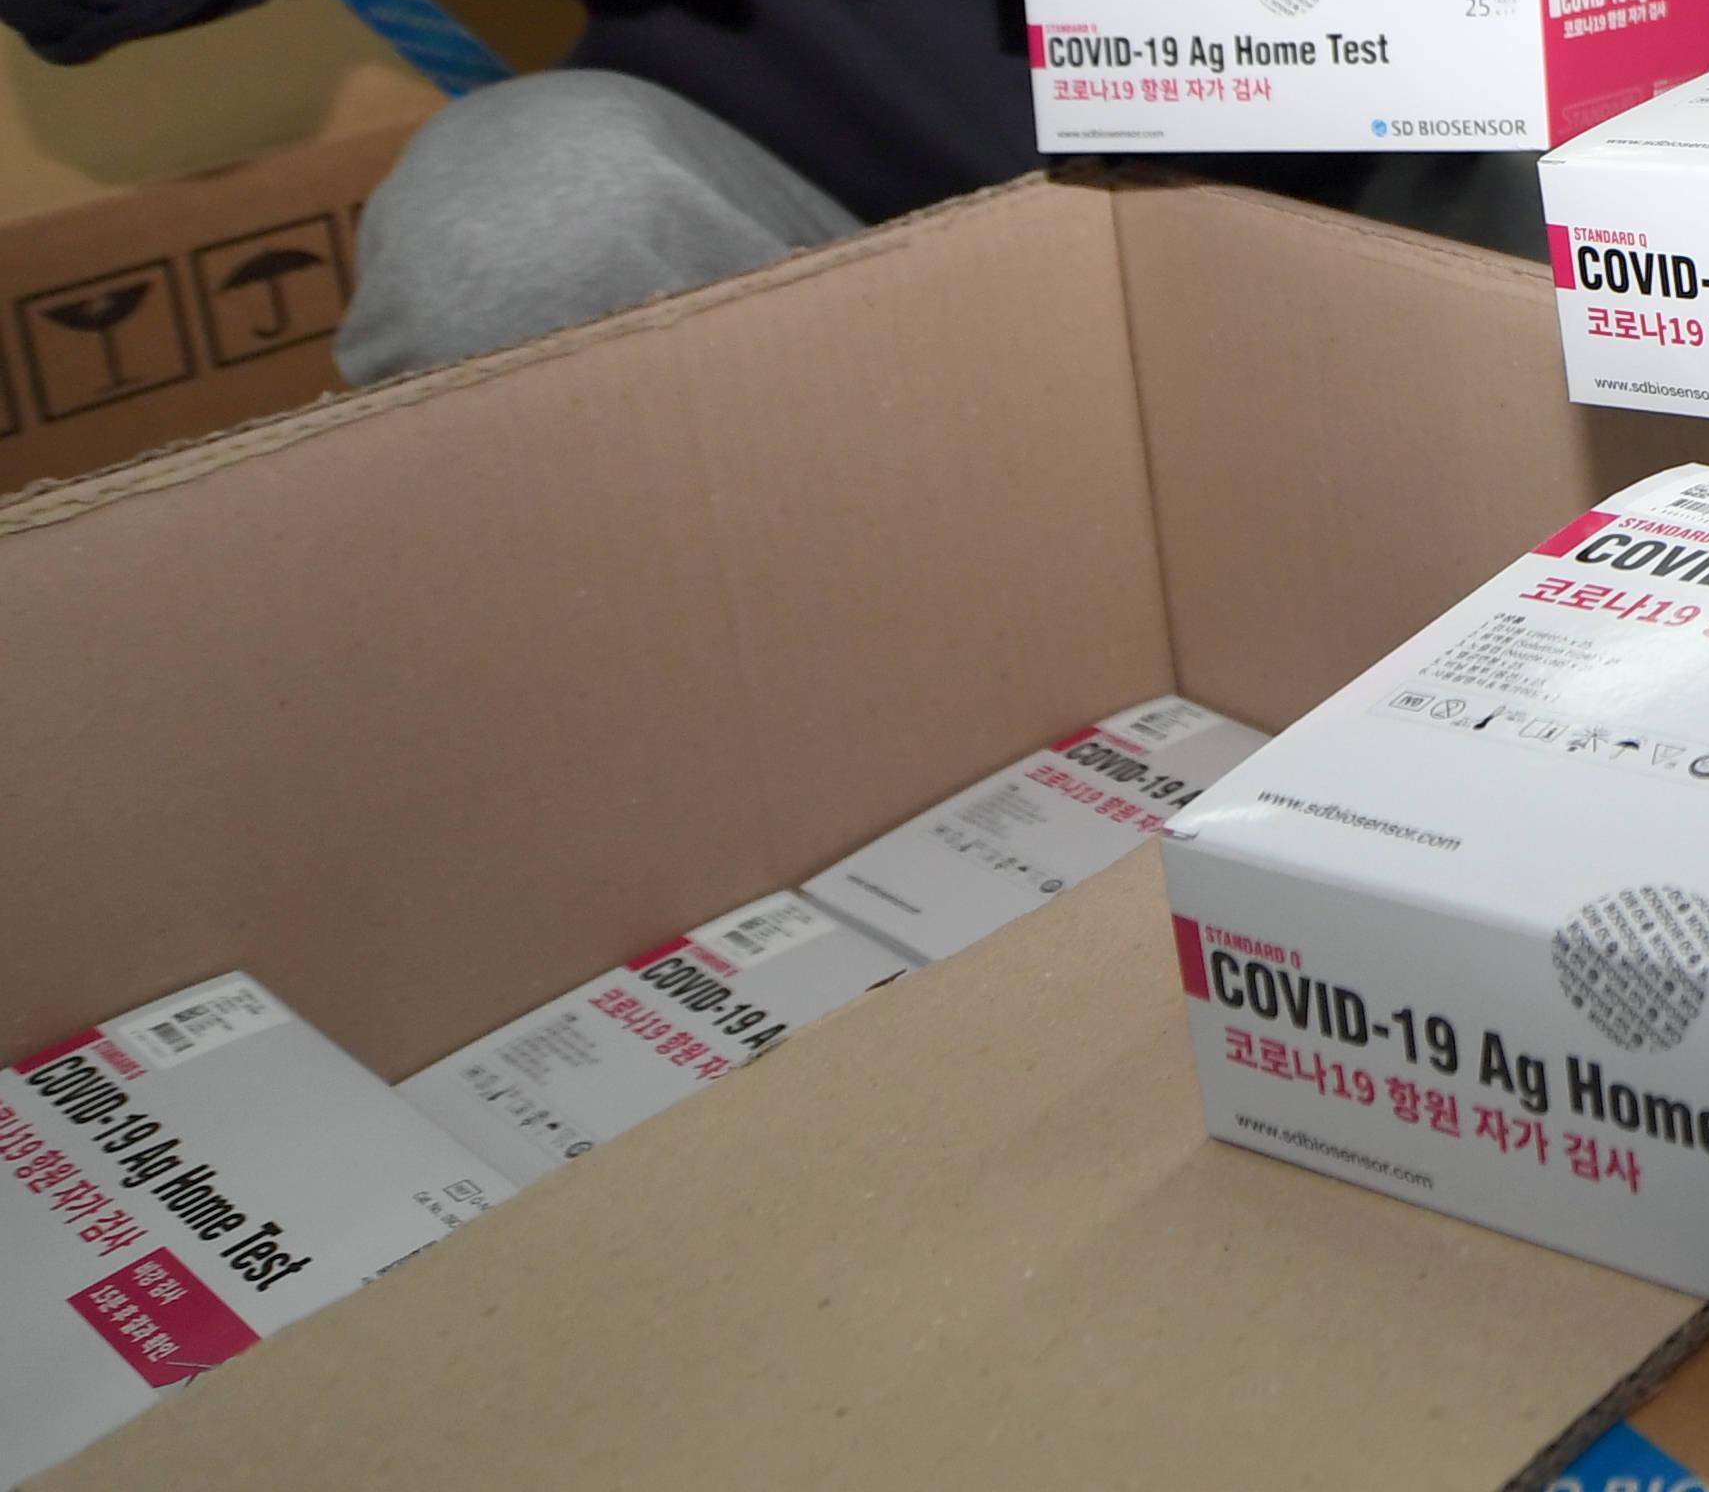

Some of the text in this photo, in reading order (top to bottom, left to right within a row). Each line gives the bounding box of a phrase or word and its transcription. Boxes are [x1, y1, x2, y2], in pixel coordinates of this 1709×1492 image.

[1048, 32, 1390, 74] COVID-19 Ag Home Test
[1053, 78, 1272, 102] 코로나19 항원 자가 검사
[1391, 119, 1527, 137] SD BIOSENSOR
[1573, 226, 1636, 248] STANDARD
[1587, 307, 1704, 347] 코로나19
[1519, 576, 1702, 627] 코로나19
[1065, 742, 1187, 802] COVID-19
[1209, 949, 1459, 1077] COVID-19
[1479, 1028, 1550, 1116] Ag
[1224, 1025, 1641, 1196] 코로나19 자가 검사
[25, 1055, 161, 1154] COVID-19
[150, 1164, 246, 1242] Home
[219, 1220, 312, 1293] Test
